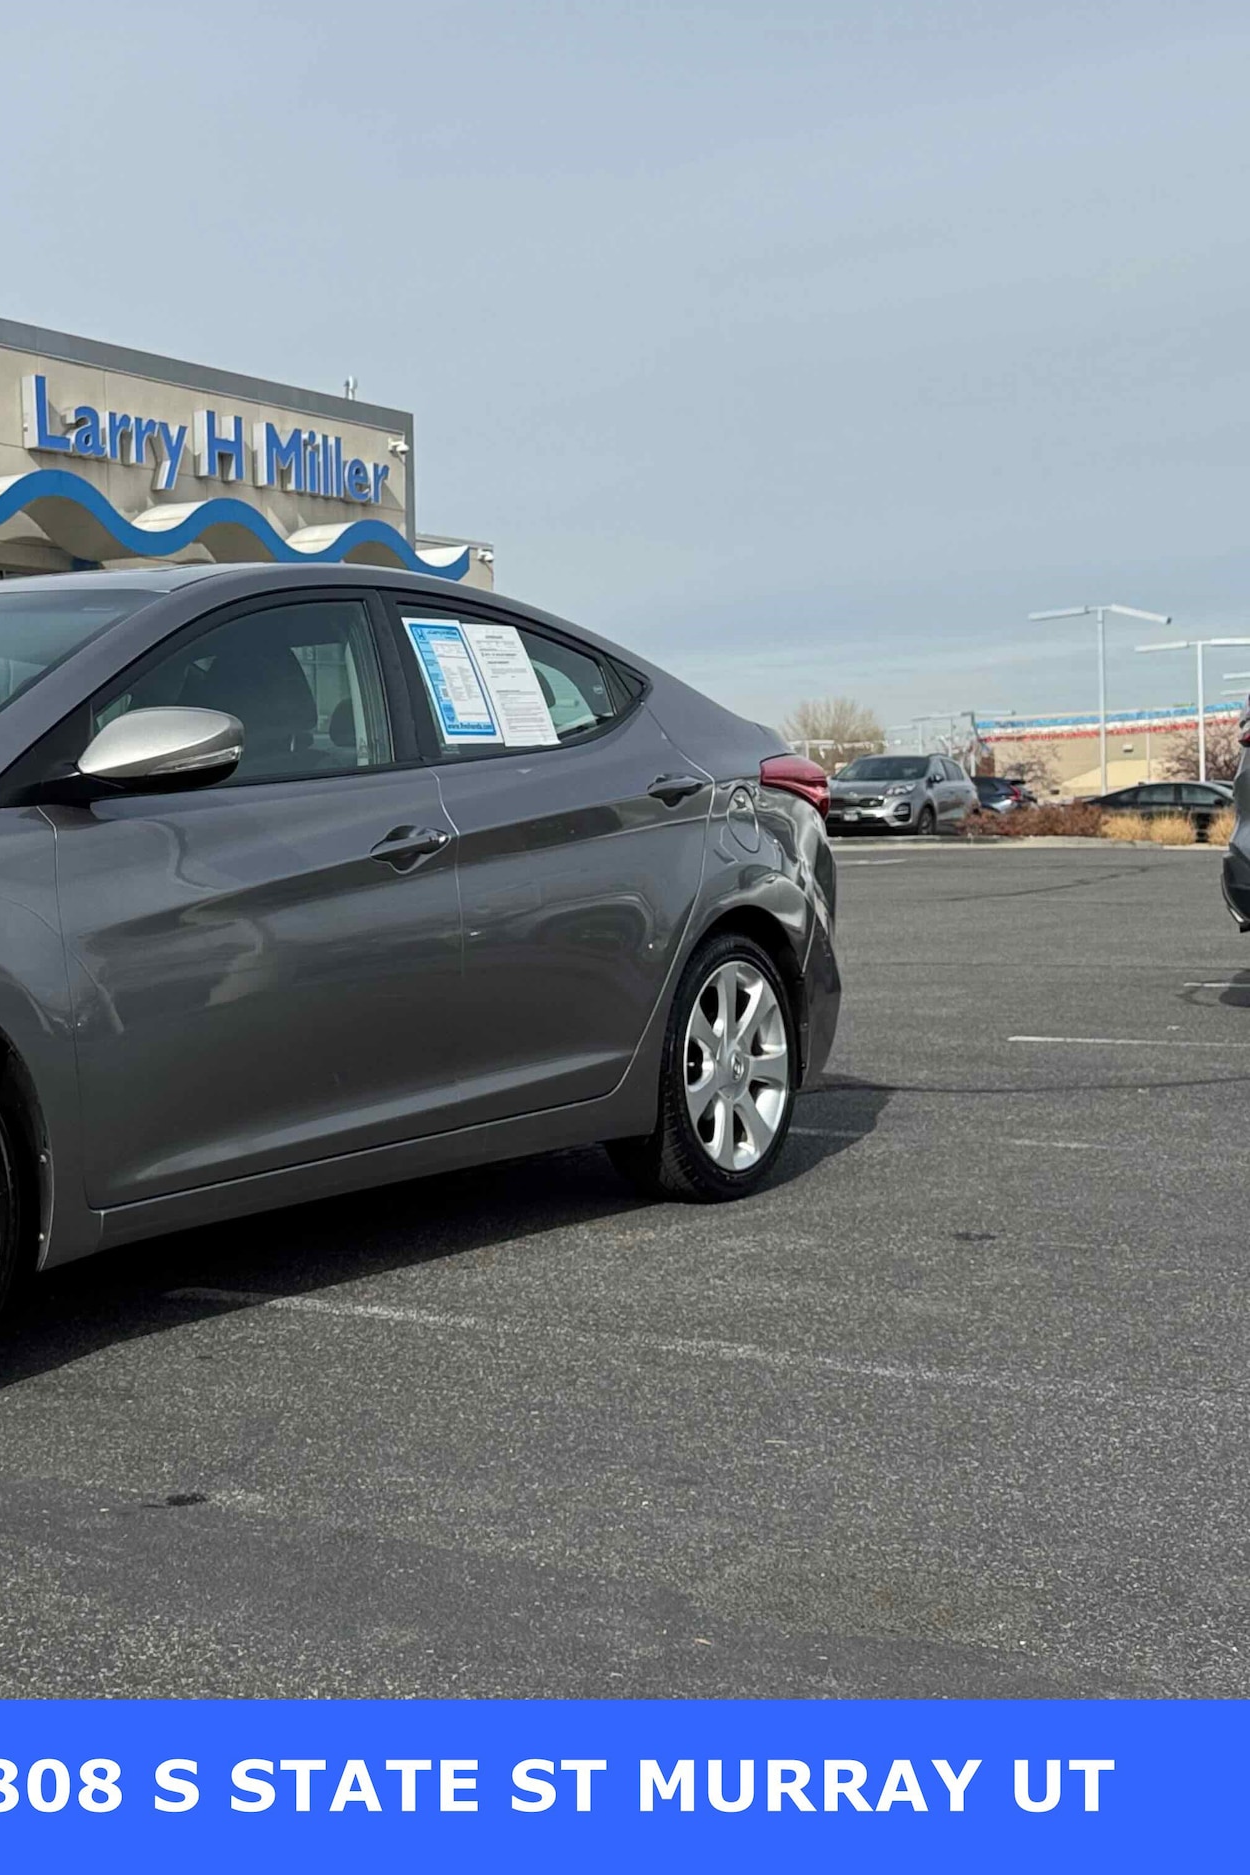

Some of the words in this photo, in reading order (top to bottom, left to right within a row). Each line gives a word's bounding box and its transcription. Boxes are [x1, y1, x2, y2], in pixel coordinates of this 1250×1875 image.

[25, 374, 189, 491] Larry
[195, 409, 244, 482] H
[256, 421, 390, 505] Miller
